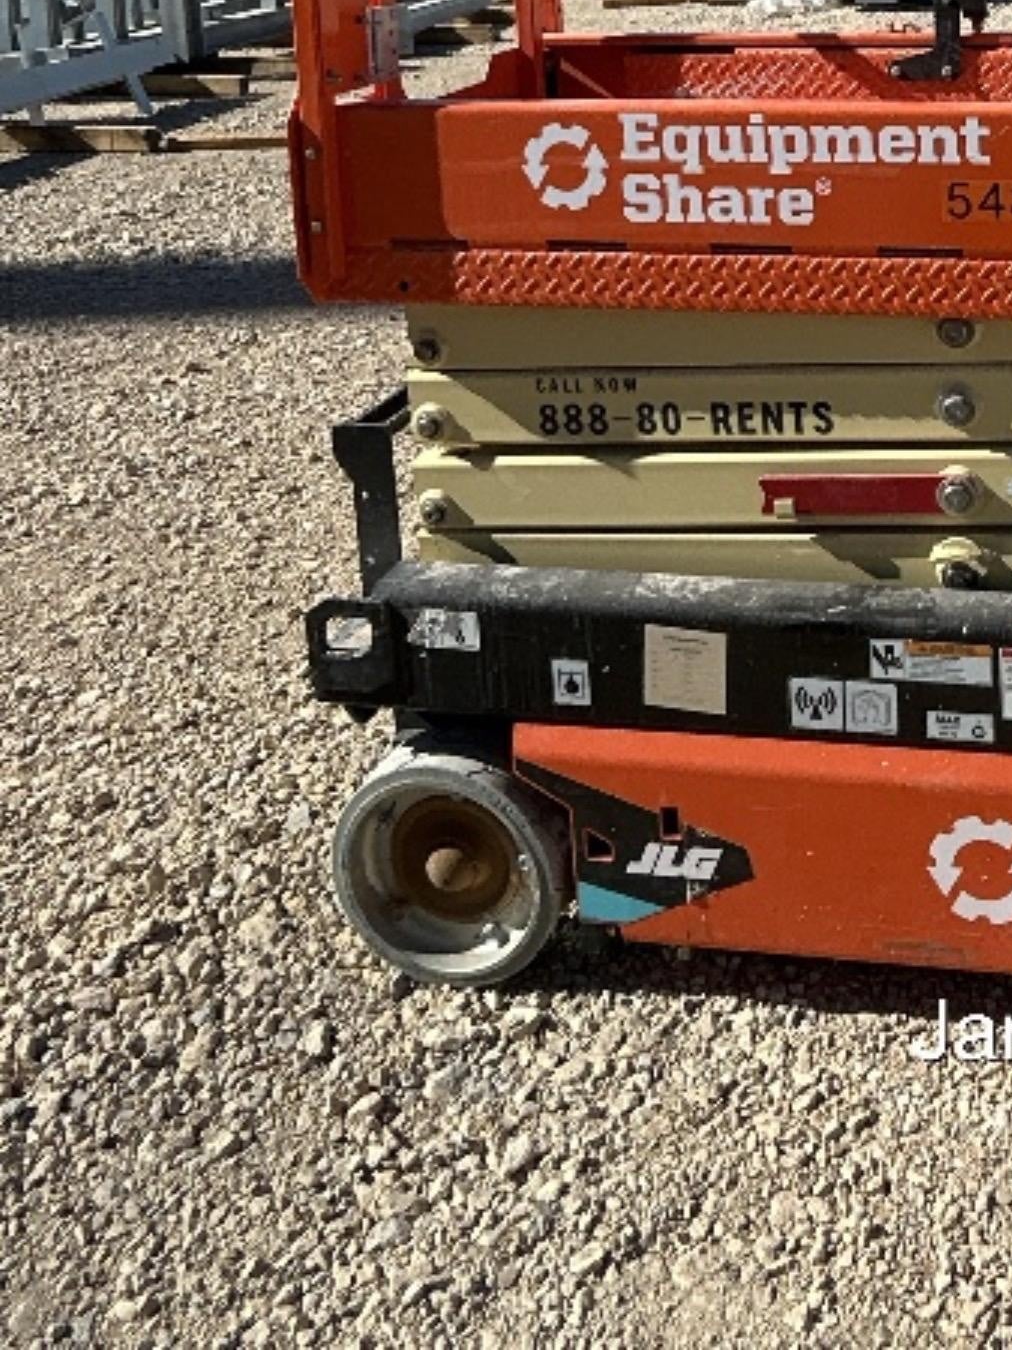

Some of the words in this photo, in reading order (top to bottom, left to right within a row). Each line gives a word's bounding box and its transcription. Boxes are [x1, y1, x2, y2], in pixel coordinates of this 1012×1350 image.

[618, 113, 992, 175] Equipment
[535, 377, 582, 394] CALL
[592, 377, 637, 394] NOW
[538, 400, 834, 436] 888-80-RENTS
[626, 843, 723, 880] JLG
